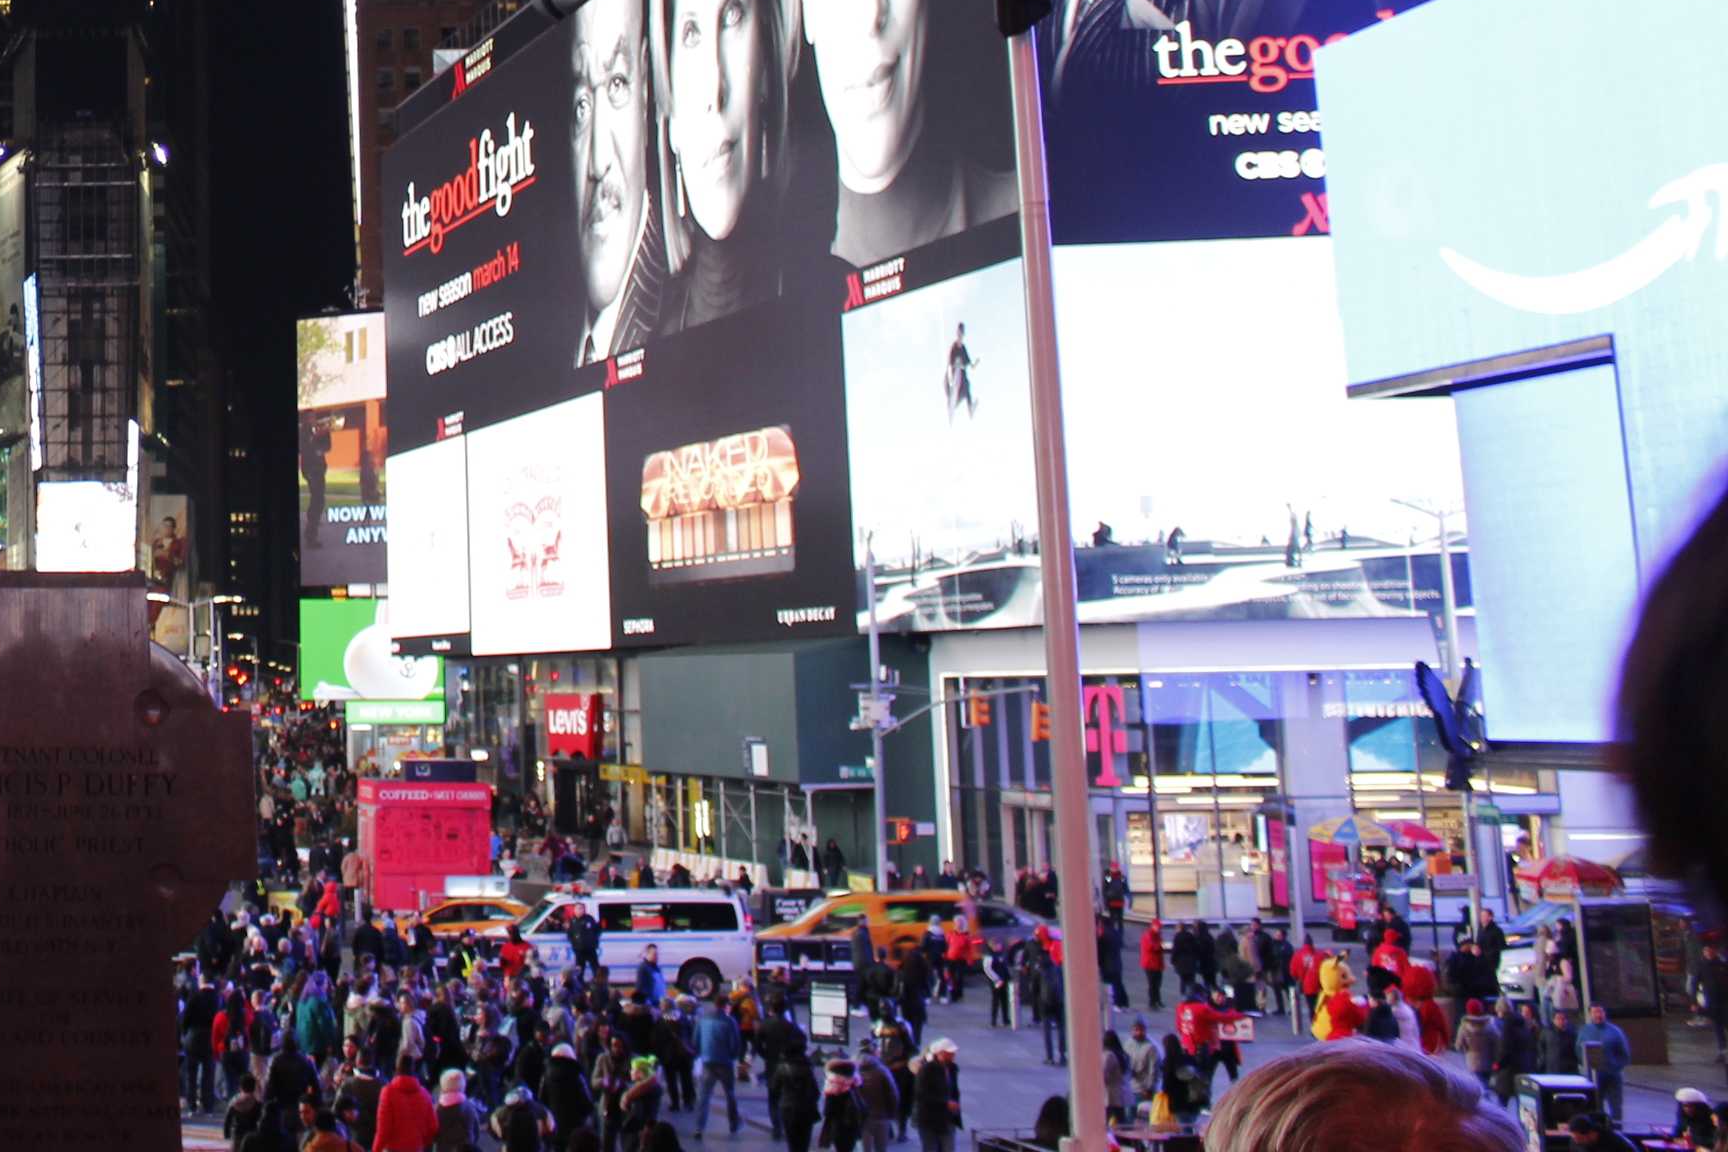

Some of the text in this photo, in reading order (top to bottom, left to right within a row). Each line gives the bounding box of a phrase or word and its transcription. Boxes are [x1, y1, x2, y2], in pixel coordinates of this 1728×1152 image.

[1209, 112, 1269, 136] new
[418, 241, 520, 318] new season march 14
[862, 256, 905, 284] MARRIOTT
[455, 330, 474, 364] ALL
[472, 311, 514, 356] ACCESS
[663, 429, 769, 479] NAKED
[328, 504, 385, 523] NOW W
[83, 771, 178, 797] DUFFY
